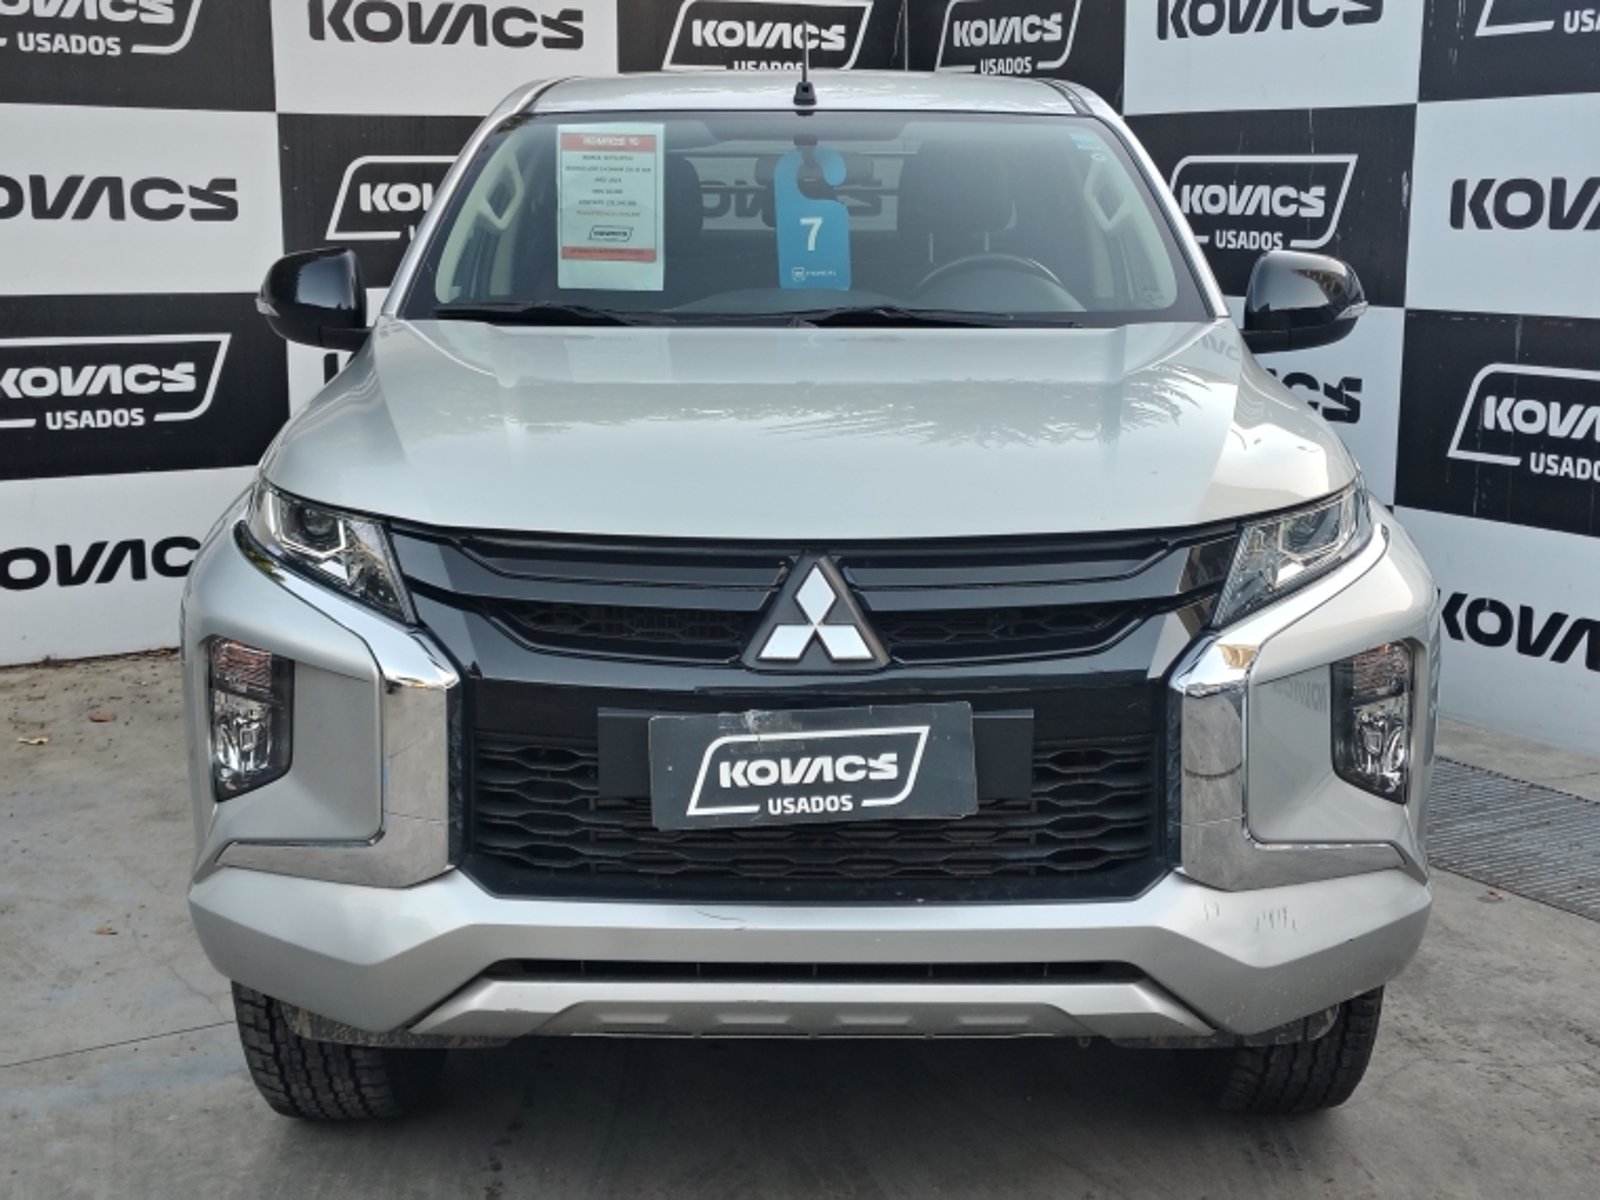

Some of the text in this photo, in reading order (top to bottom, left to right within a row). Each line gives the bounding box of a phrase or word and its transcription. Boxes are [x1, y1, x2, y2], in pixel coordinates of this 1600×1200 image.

[308, 0, 584, 50] KOVACS
[692, 19, 846, 51] KOVACS
[953, 12, 1062, 47] KOVACS
[17, 32, 121, 56] USADOS
[980, 56, 1032, 75] USADOS
[1181, 184, 1325, 218] KOVACS
[1449, 176, 1600, 230] KOV
[799, 216, 823, 251] 7
[1215, 230, 1283, 251] USADOS
[45, 408, 145, 430] USADOS
[719, 752, 898, 788] KOVACS
[768, 795, 853, 815] USADOS
